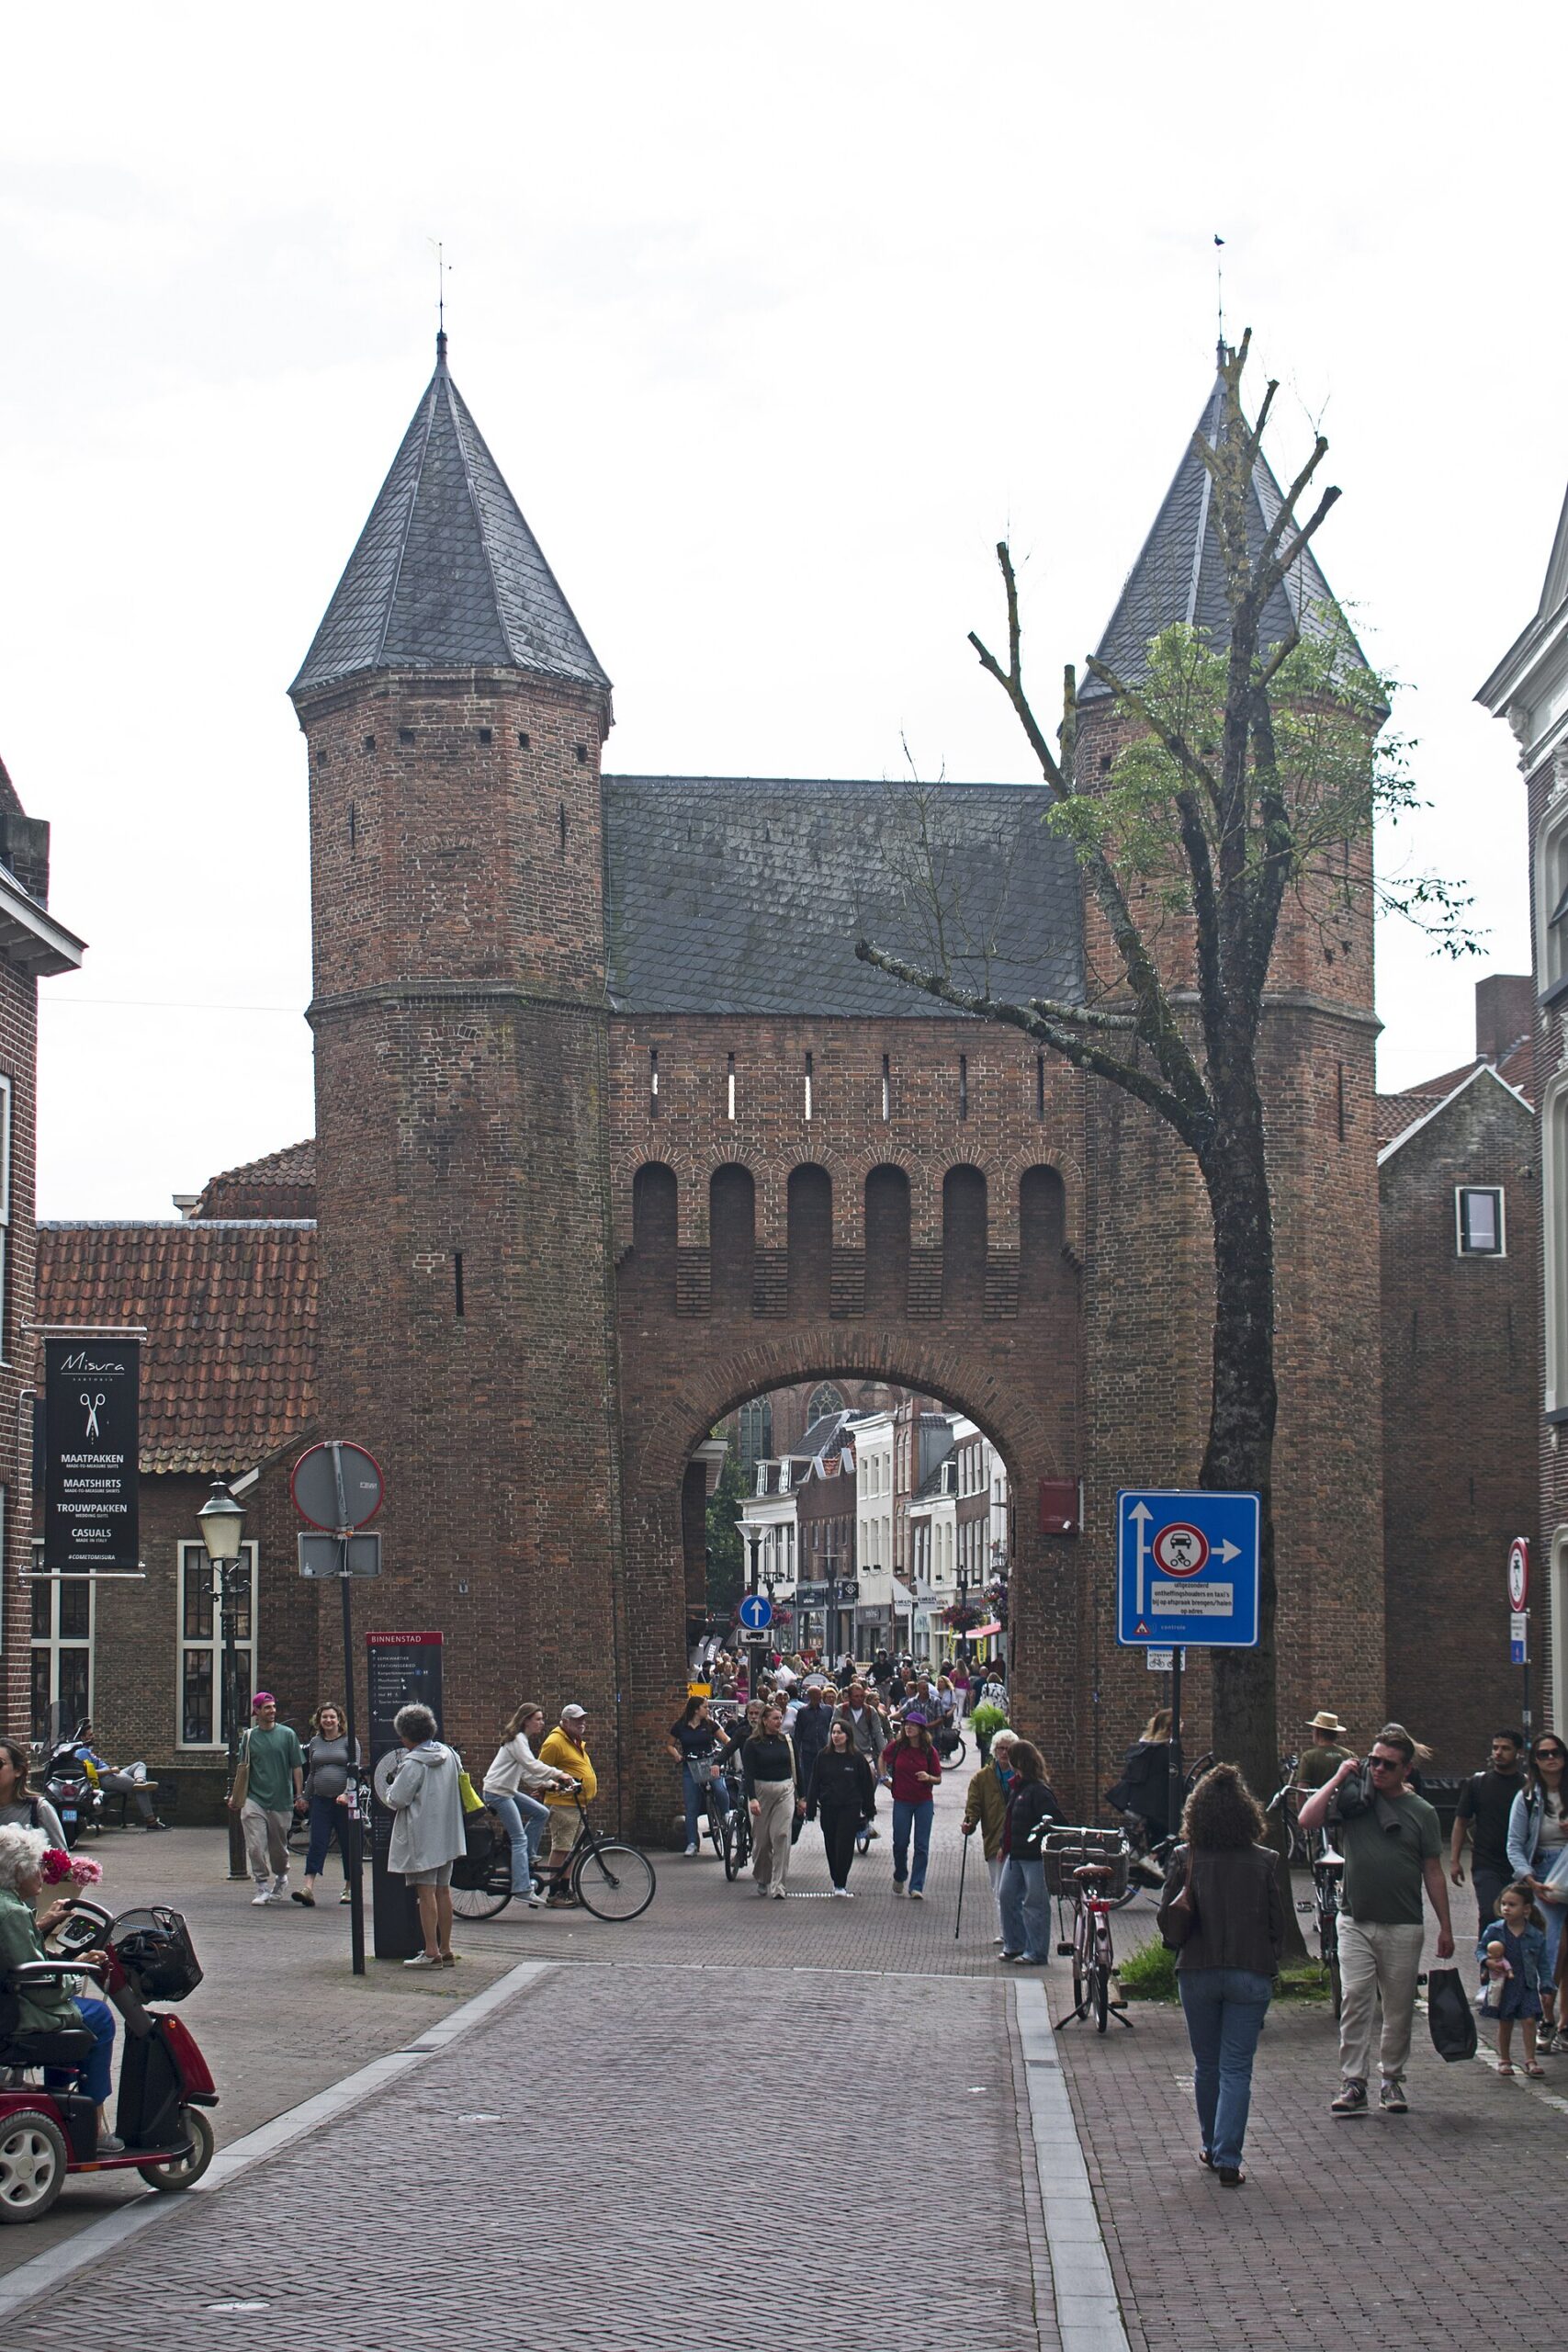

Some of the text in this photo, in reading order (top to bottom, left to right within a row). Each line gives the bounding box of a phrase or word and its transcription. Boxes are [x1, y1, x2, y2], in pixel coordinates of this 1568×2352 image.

[61, 1351, 125, 1371] Misura
[61, 1454, 124, 1463] MAATPAKKEN
[63, 1479, 121, 1487] MAATSHIRTS
[57, 1504, 128, 1512] TROUWPAKKEN
[72, 1529, 112, 1537] CASUALS
